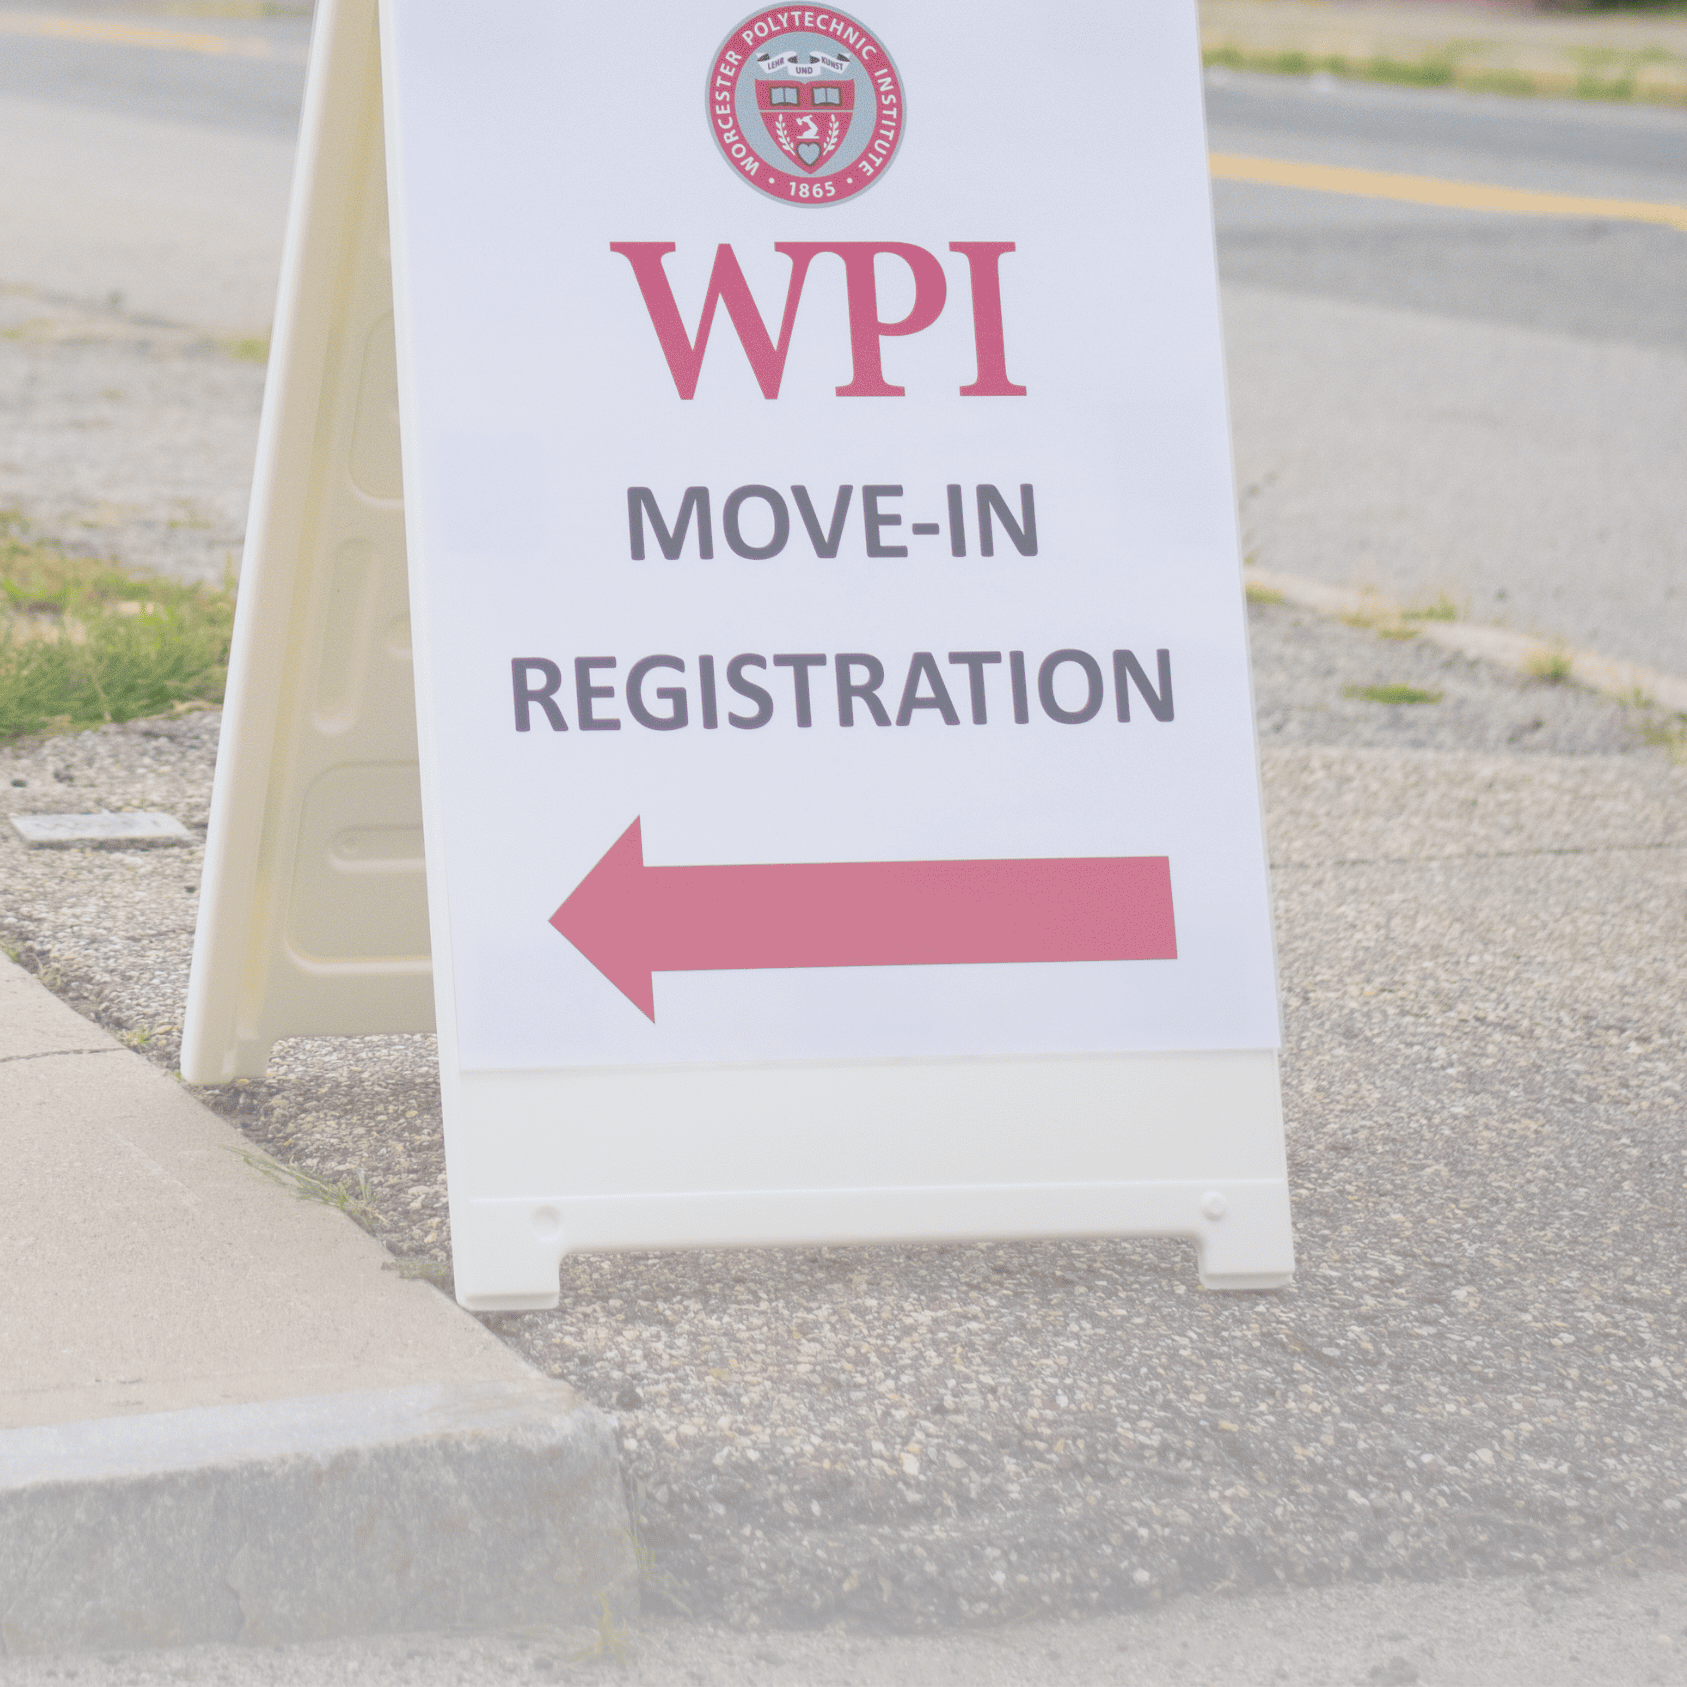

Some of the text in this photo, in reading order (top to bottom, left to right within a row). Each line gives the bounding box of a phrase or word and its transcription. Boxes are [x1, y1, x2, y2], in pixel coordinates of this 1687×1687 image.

[715, 11, 898, 176] WORCESTER POLYTECHNIC INSTITUTE
[767, 56, 844, 74] LEHR UND KUNST
[789, 181, 837, 198] 1865
[609, 240, 1028, 401] WPI
[626, 482, 1040, 561] MOVE-IN
[510, 648, 1176, 733] REGISTRATION
